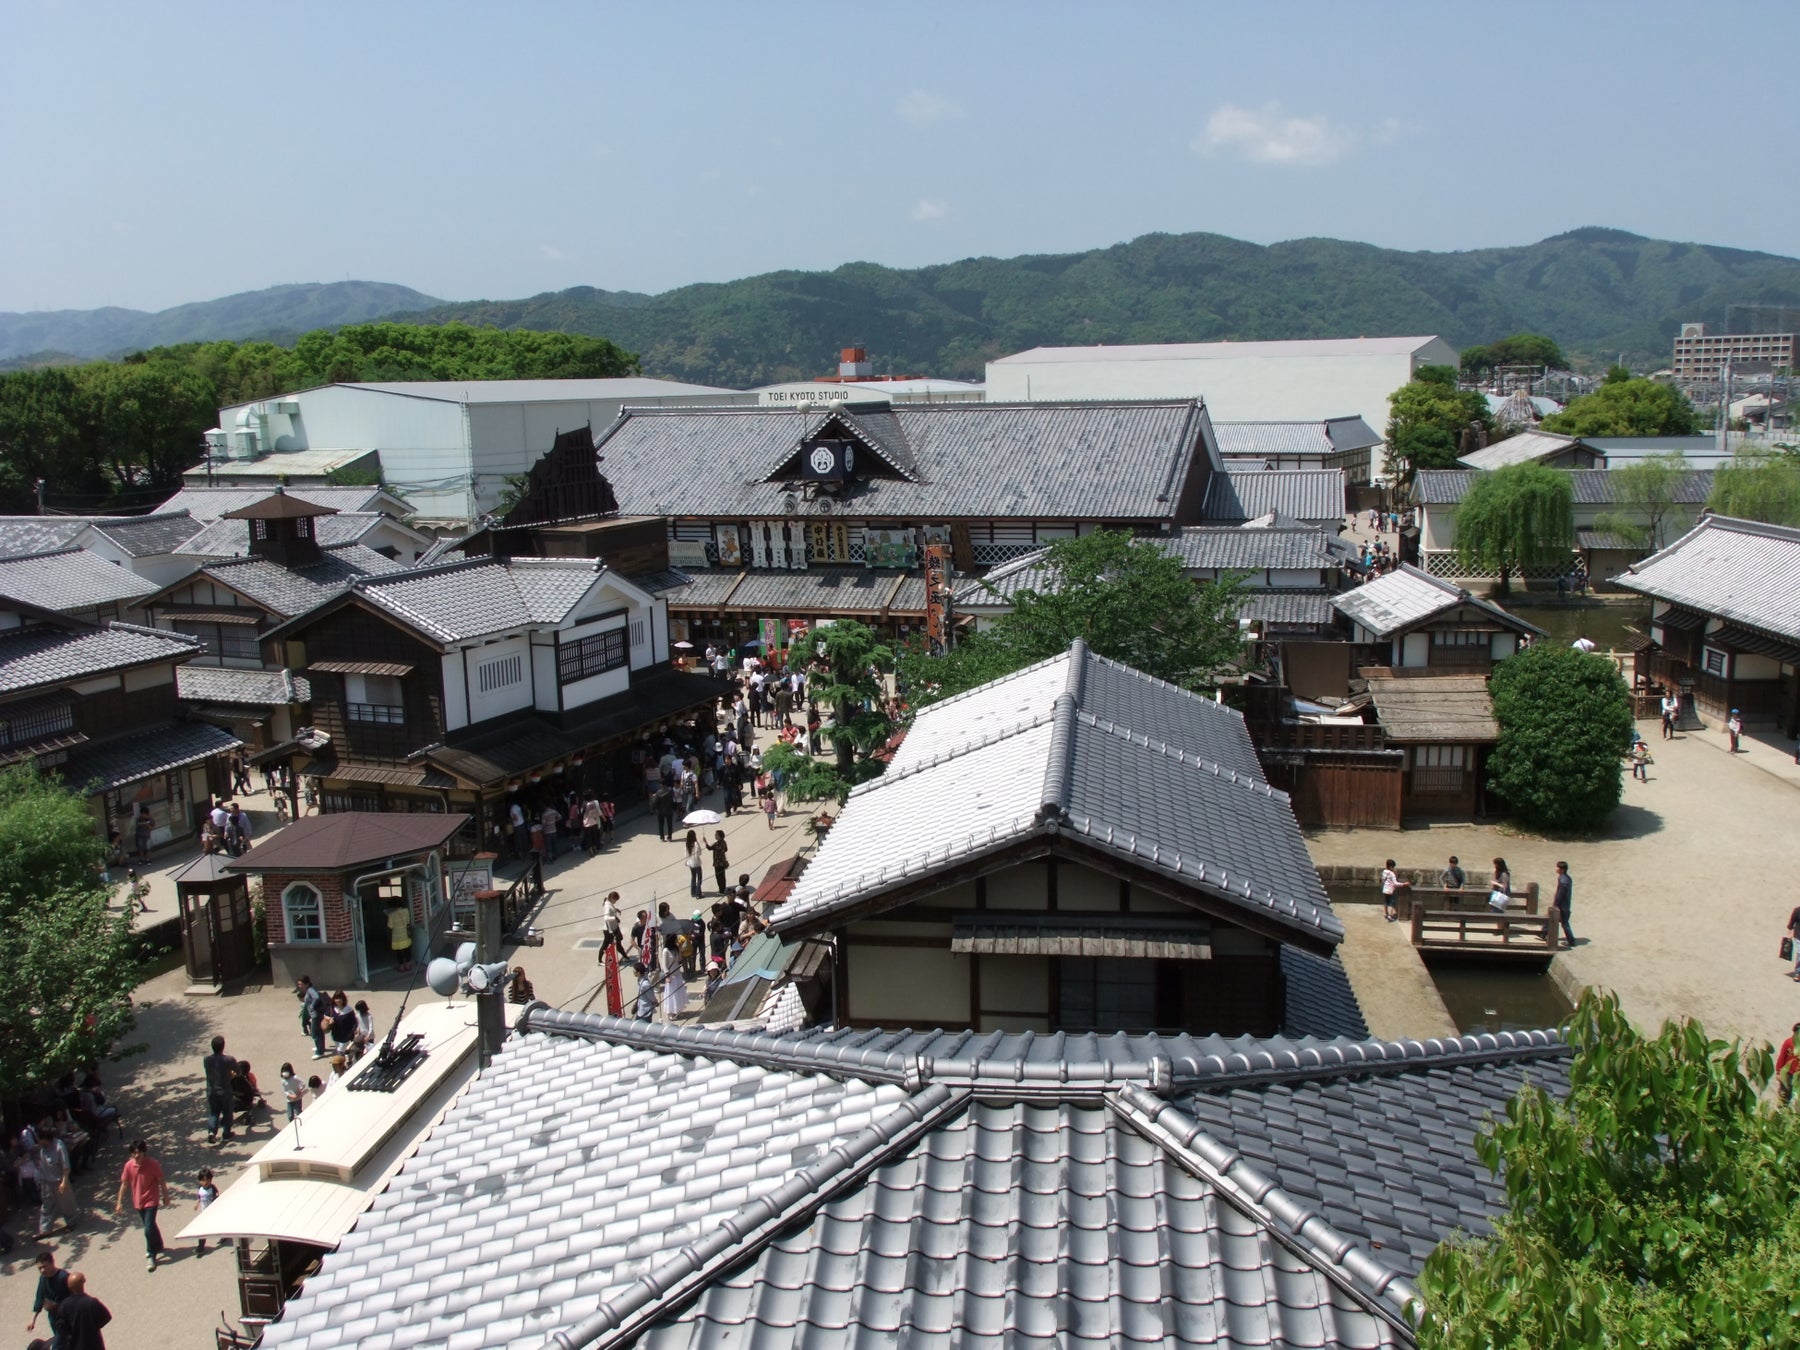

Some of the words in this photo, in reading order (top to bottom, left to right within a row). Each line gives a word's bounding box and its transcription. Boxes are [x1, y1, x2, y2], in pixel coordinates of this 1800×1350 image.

[768, 392, 788, 401] TOEI
[790, 391, 815, 401] KYOTO
[818, 391, 849, 400] STUDIO
